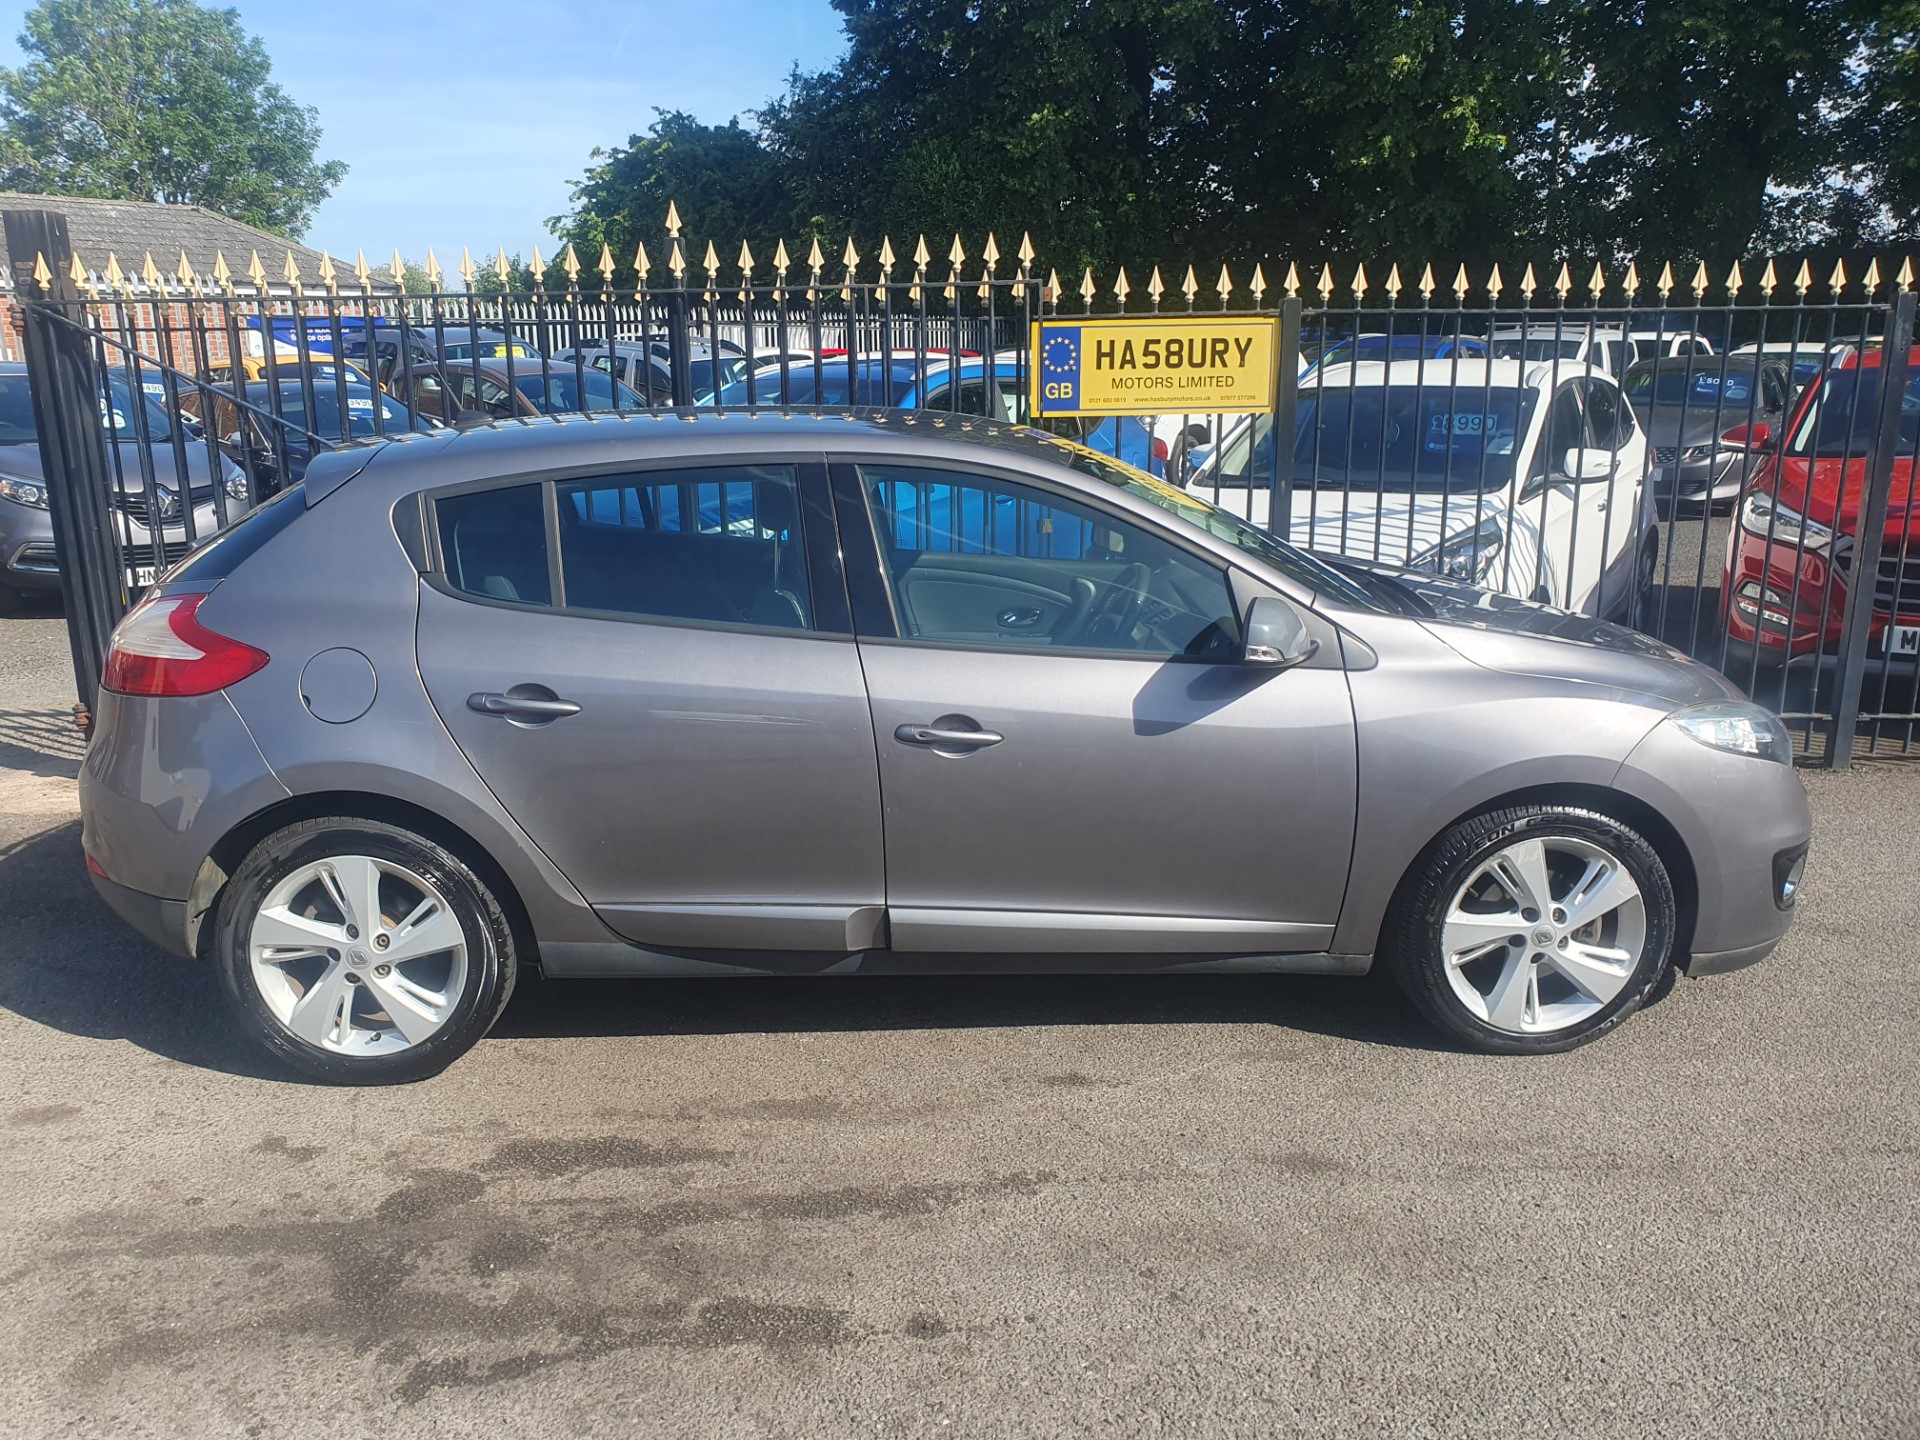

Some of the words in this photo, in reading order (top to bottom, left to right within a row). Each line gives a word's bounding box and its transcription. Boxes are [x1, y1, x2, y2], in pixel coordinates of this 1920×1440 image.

[1096, 338, 1253, 370] HA58URY
[1111, 377, 1174, 389] MOTORS
[1178, 375, 1235, 388] LIMITED
[1698, 376, 1735, 386] £SOD
[1045, 382, 1073, 399] GB
